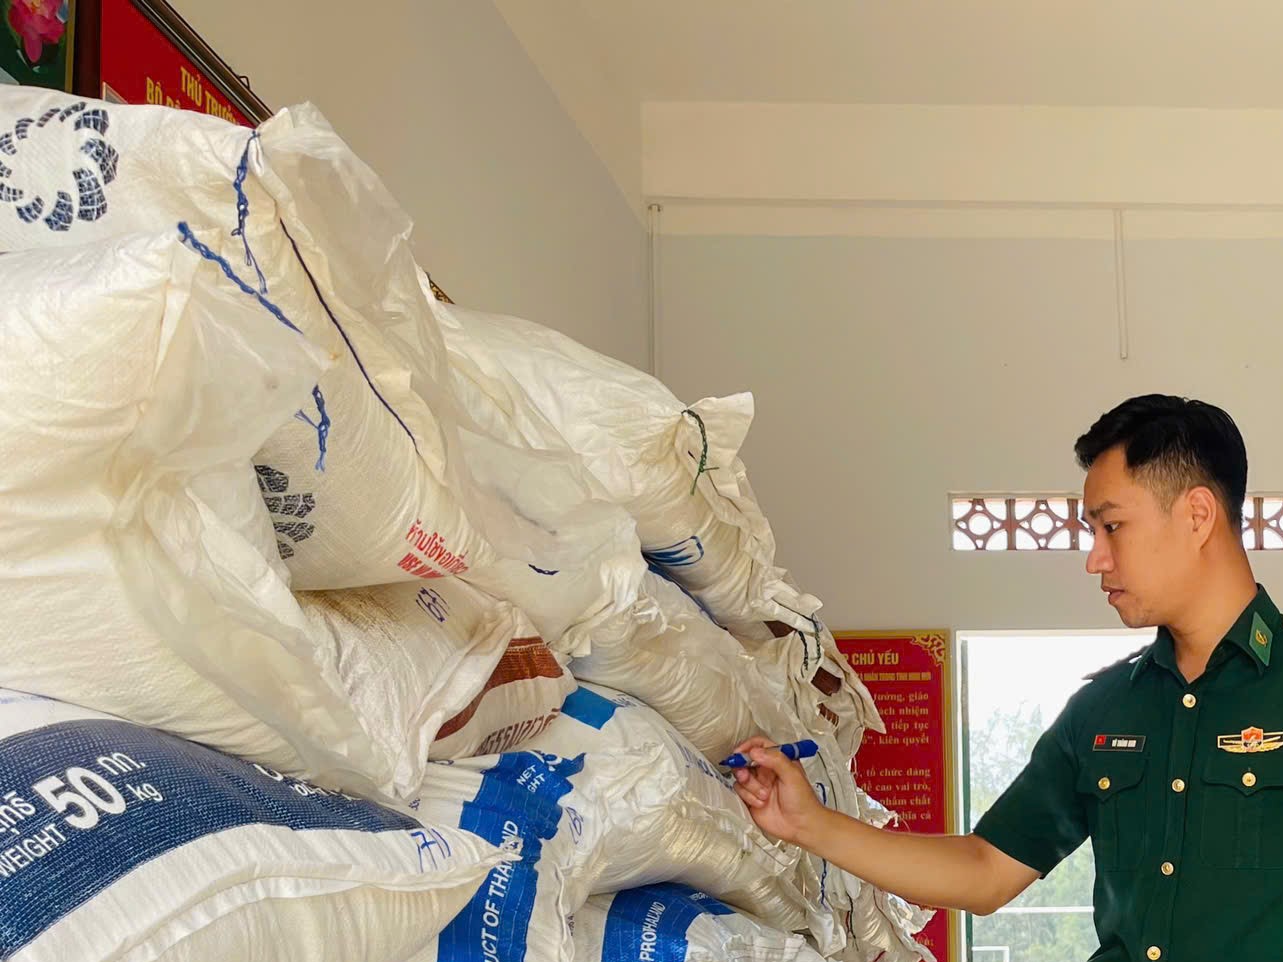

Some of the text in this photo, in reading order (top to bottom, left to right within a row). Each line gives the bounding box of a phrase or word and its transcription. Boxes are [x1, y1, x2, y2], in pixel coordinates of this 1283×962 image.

[851, 648, 899, 665] CHỦ YẾU
[516, 764, 537, 786] NET
[33, 767, 164, 830] 50 kg
[482, 899, 500, 928] OF
